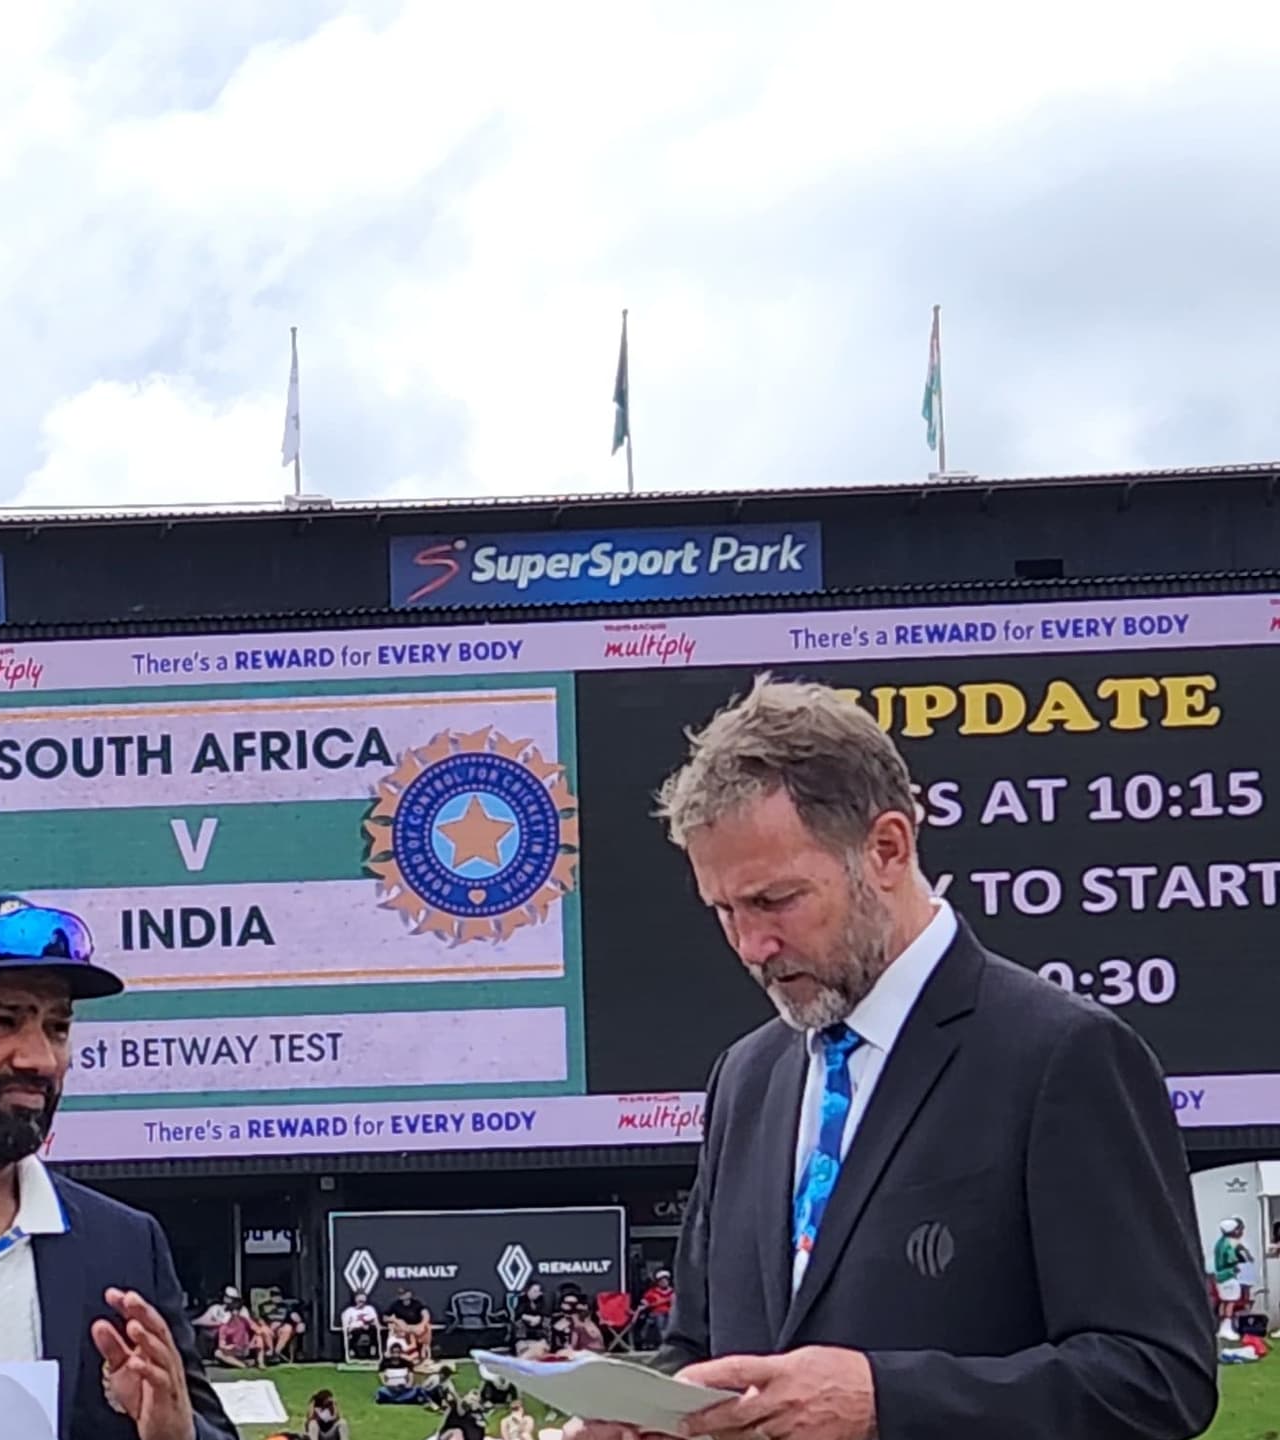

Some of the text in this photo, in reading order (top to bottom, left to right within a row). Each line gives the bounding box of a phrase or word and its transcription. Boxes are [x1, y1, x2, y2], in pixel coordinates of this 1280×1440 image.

[471, 534, 807, 588] SuperSport Park
[603, 632, 697, 664] multiply
[789, 613, 1190, 651] There's a REWARD for EVERY BODY
[132, 640, 523, 674] There's a REWARD for EVERY BODY
[191, 727, 393, 774] AFRICA
[980, 778, 1068, 824] AT
[1088, 770, 1263, 821] 10:15
[170, 818, 218, 872] V
[970, 869, 1062, 916] TO
[1082, 861, 1280, 914] START
[122, 905, 276, 951] INDIA
[1038, 957, 1176, 1006] 0:30
[68, 1032, 343, 1069] st BETWAY TEST
[1171, 1090, 1205, 1111] DY
[144, 1111, 537, 1143] There's a REWARD for EVERY BODY
[384, 1264, 458, 1279] RENAULT
[539, 1259, 612, 1275] RENAULT
